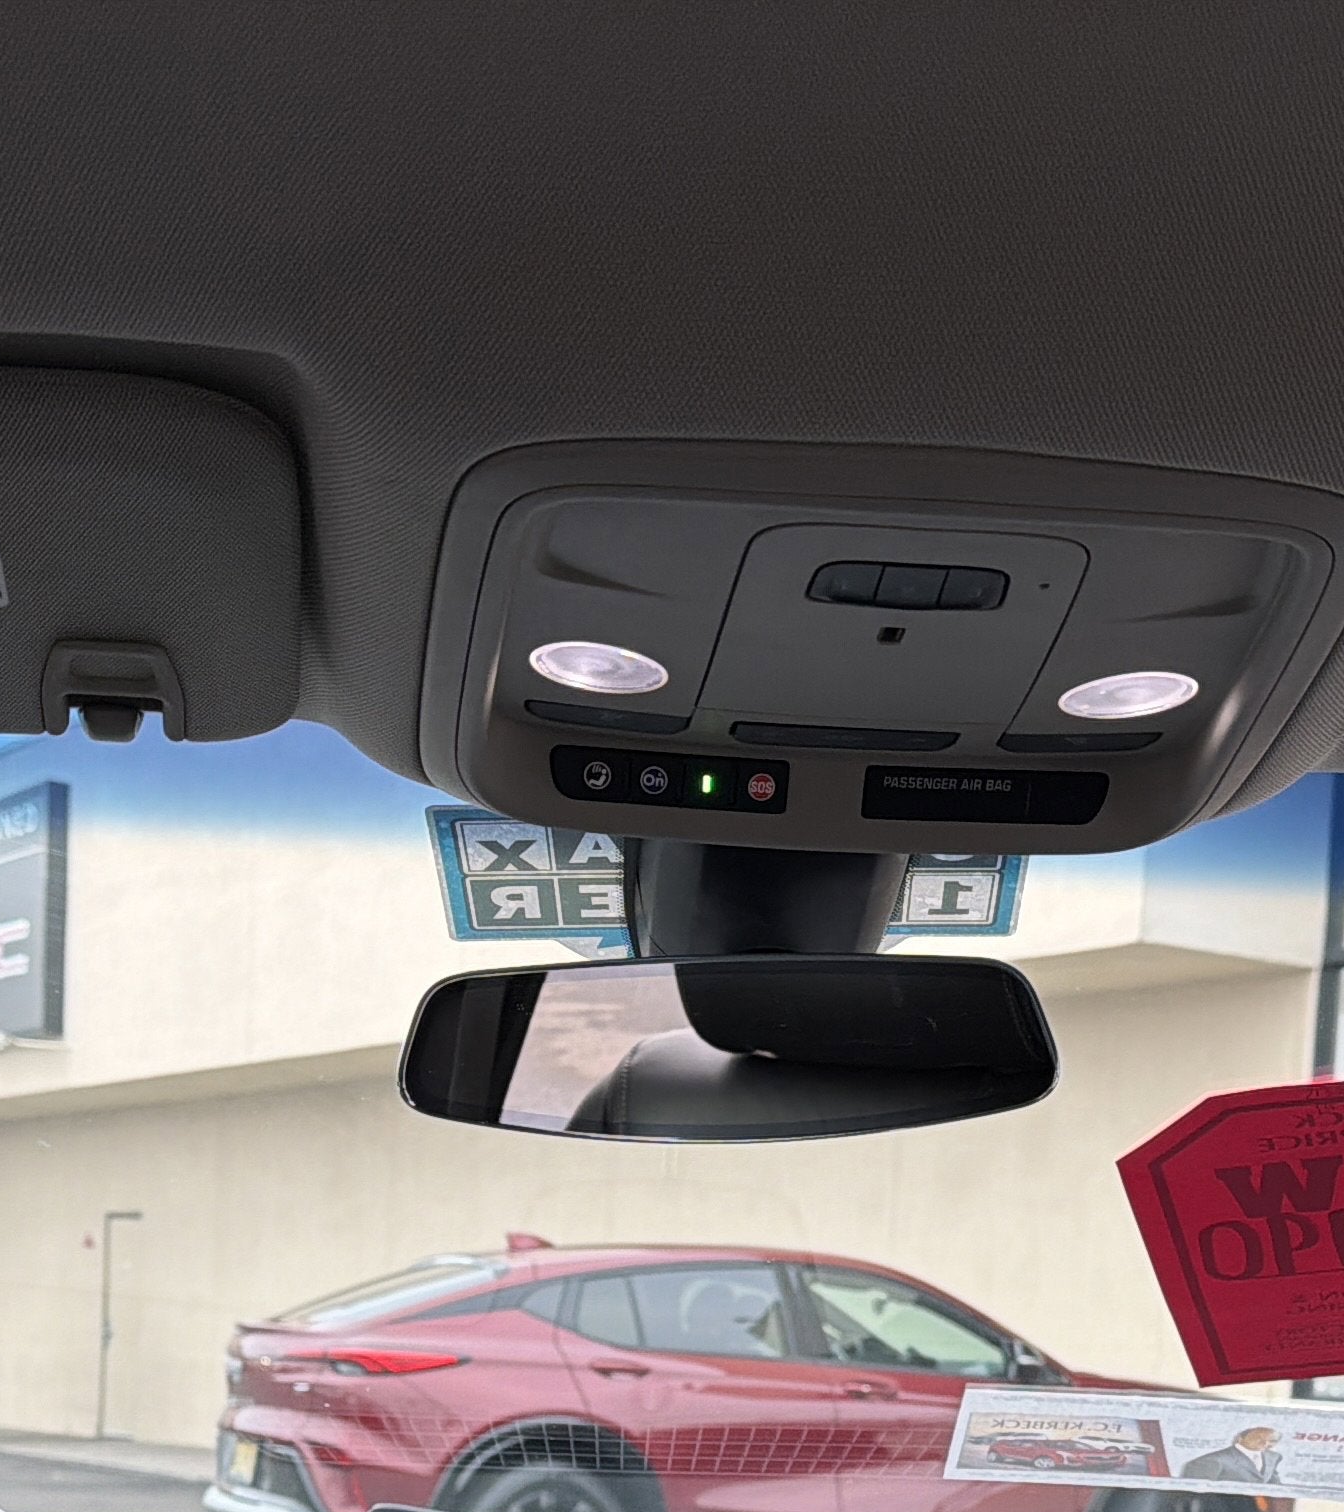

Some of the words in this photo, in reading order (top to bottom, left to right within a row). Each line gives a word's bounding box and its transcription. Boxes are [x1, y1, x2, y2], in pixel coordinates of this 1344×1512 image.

[750, 780, 774, 795] SOS
[883, 775, 957, 791] PASSENGER
[960, 778, 983, 791] AIR
[986, 779, 1011, 793] BAG
